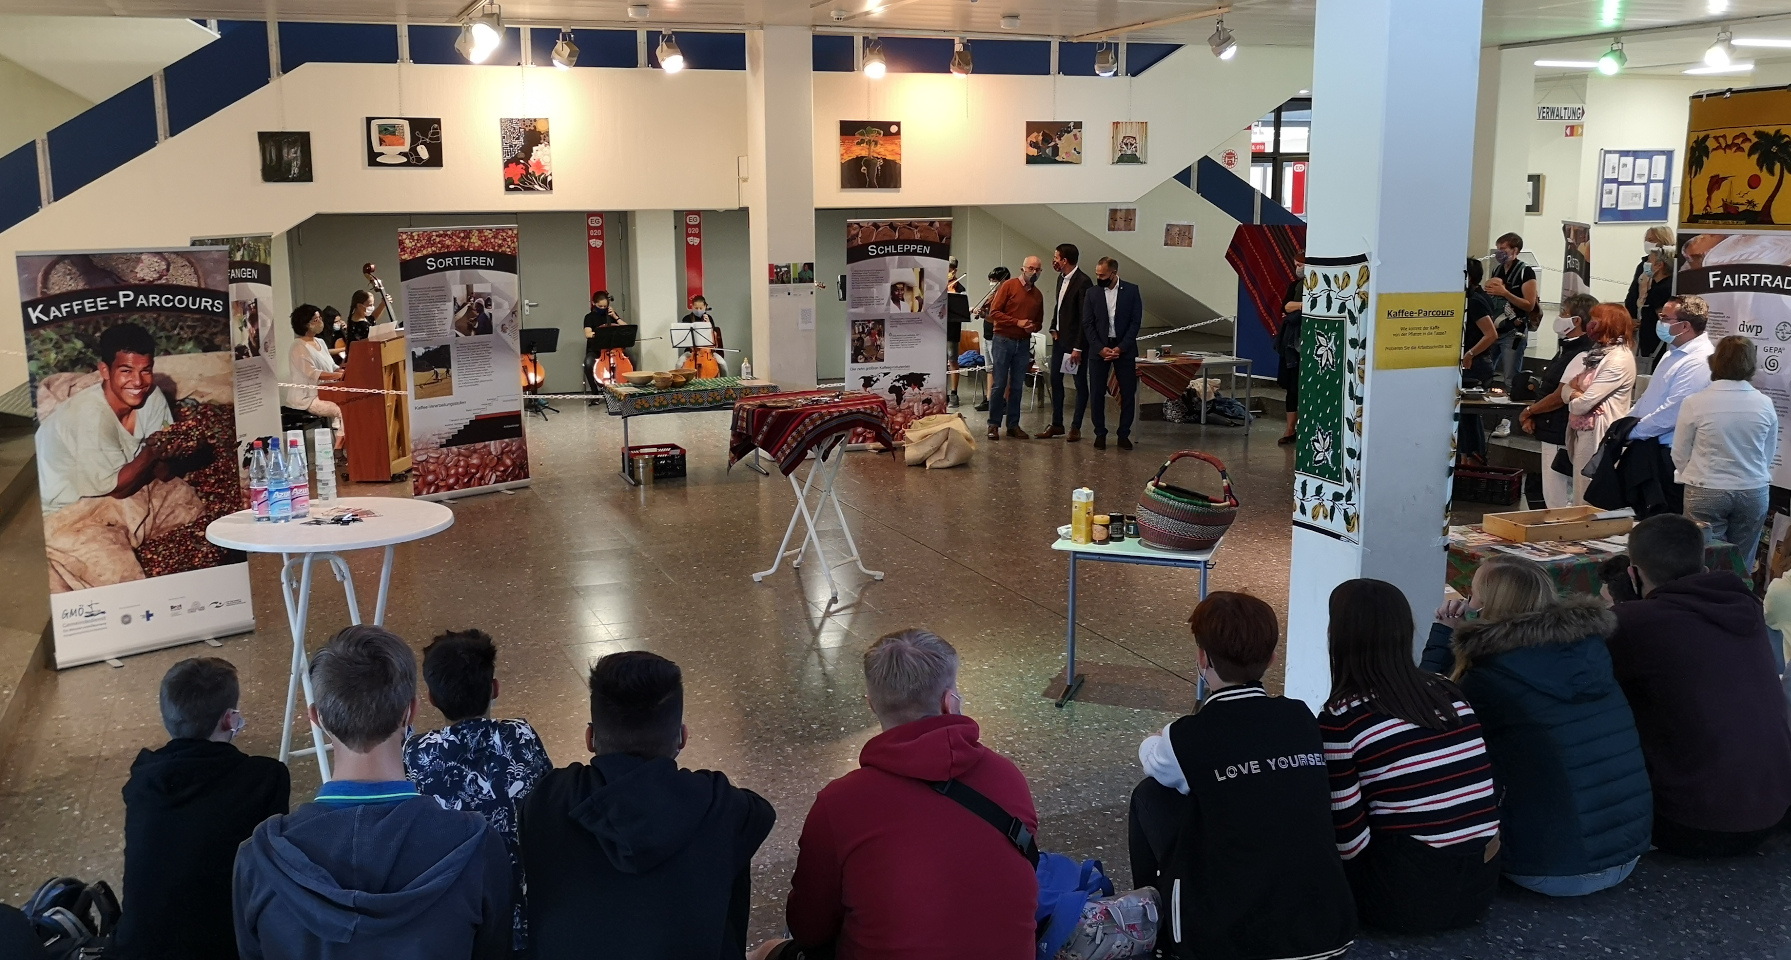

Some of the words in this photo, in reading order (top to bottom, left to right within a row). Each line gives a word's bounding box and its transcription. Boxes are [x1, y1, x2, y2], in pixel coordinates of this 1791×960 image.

[1537, 106, 1582, 120] VERWALTUNG
[868, 244, 931, 256] SCHLEPPEN
[426, 256, 495, 270] SORTIEREN
[27, 290, 223, 325] KAFFEE-PARCOURS
[1387, 308, 1454, 318] Kaffee-Parcours
[1738, 320, 1763, 336] dwp
[1763, 346, 1783, 354] GEPA
[61, 604, 84, 620] GMÖ
[1214, 760, 1261, 781] LOVE
[1266, 753, 1327, 771] YOURSEL
